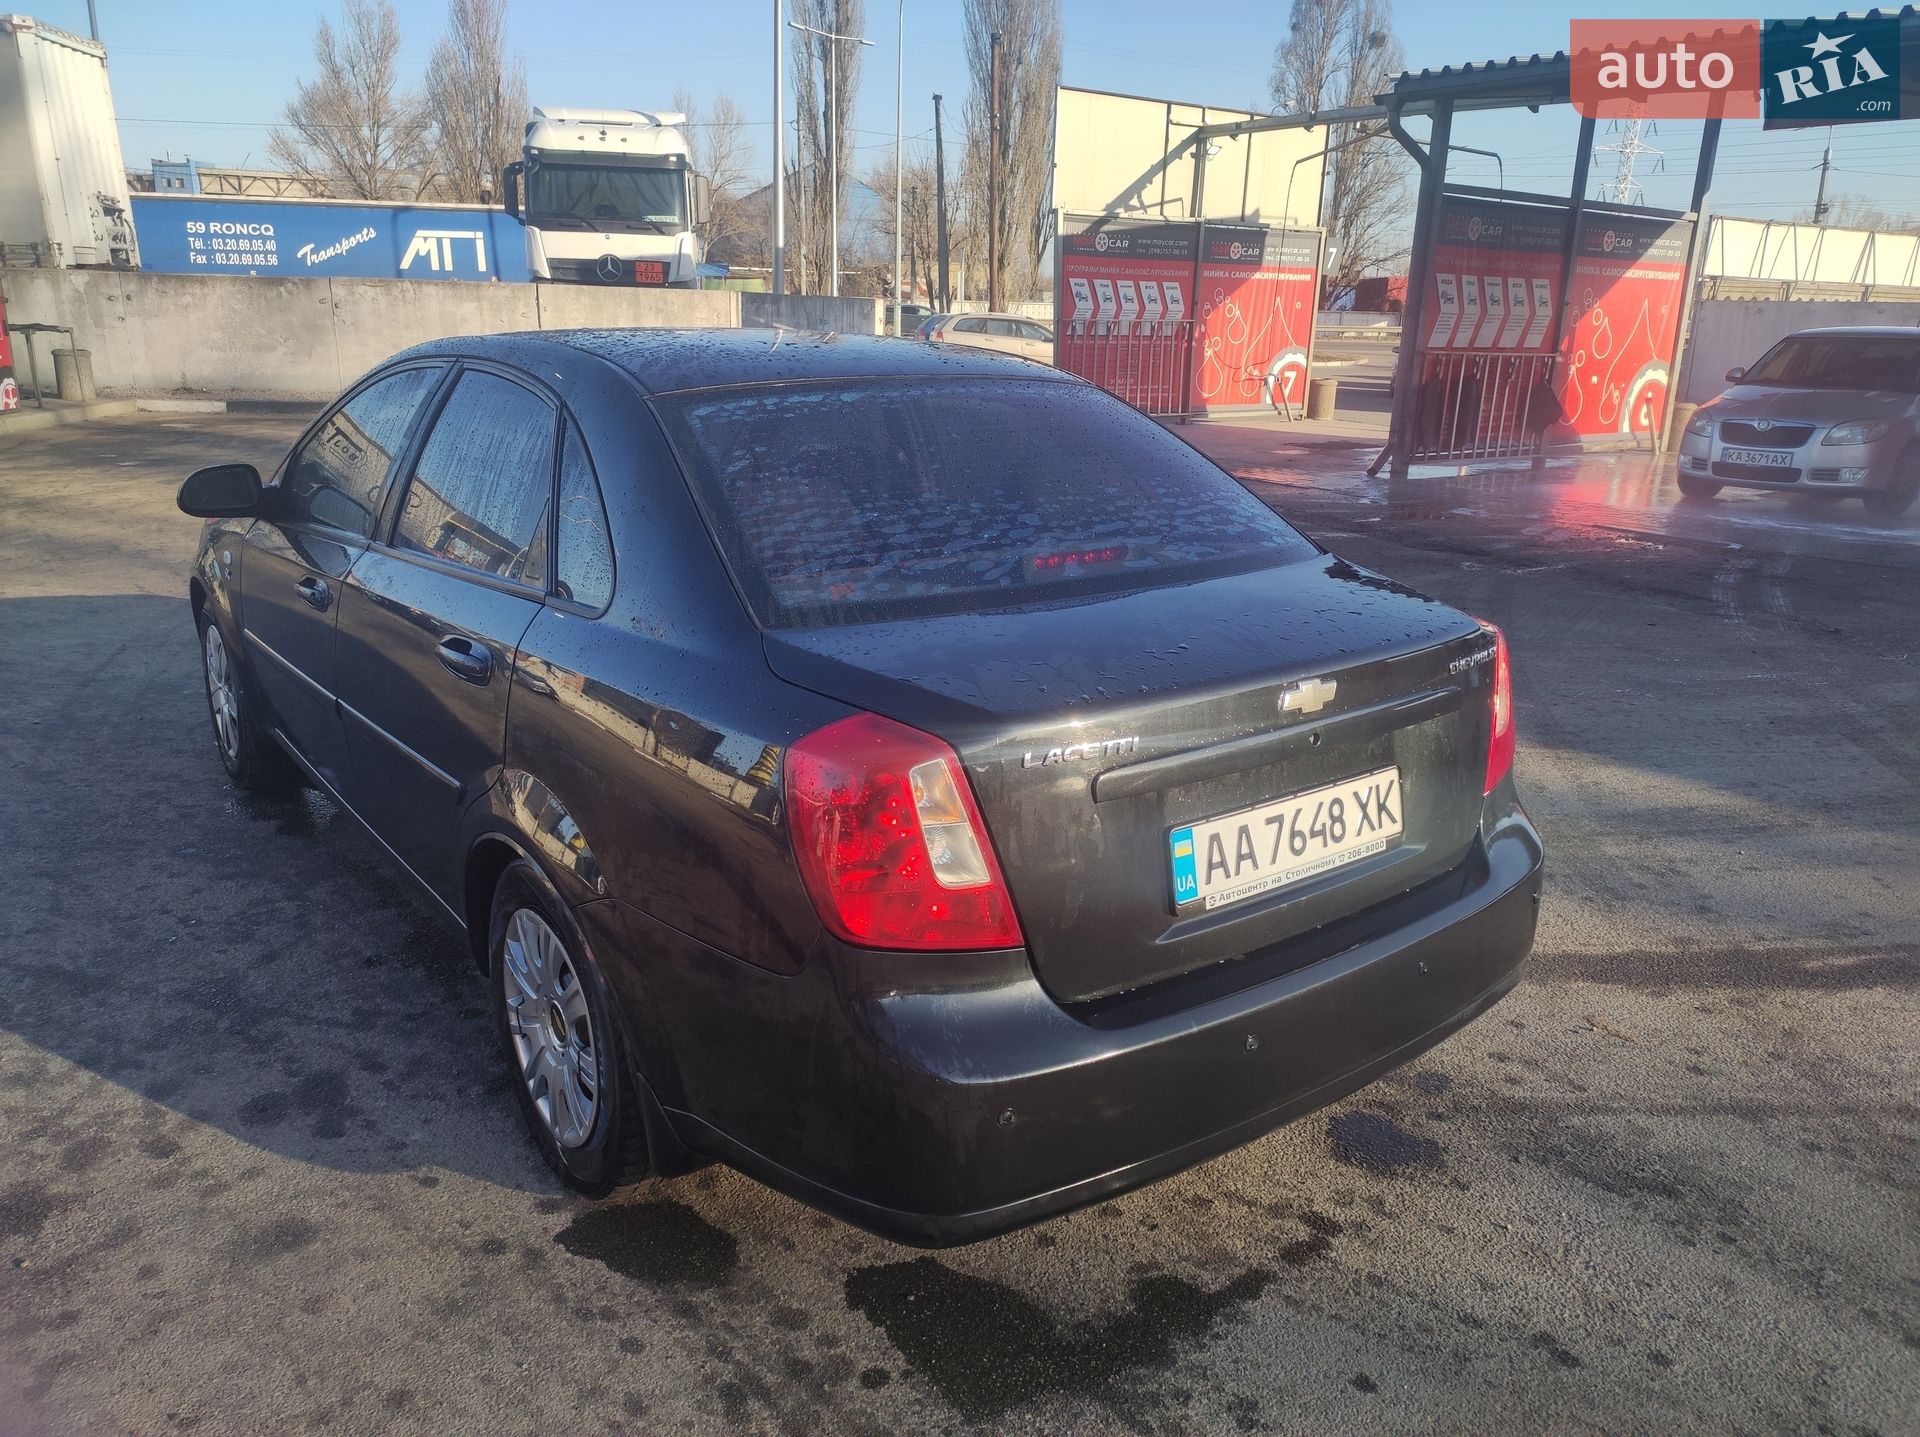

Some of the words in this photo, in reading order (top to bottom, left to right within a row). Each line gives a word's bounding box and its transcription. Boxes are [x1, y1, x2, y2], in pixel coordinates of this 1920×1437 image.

[186, 222, 206, 233] 59
[209, 222, 275, 236] RONCQ
[1481, 225, 1503, 236] CAR
[297, 226, 377, 267] Transports
[1108, 239, 1129, 248] CAR
[1615, 238, 1632, 248] CAR
[190, 252, 207, 264] Fax
[1241, 247, 1260, 256] CAR
[1327, 247, 1338, 269] 7
[643, 263, 655, 271] 23
[1203, 269, 1229, 277] МИЙКА
[639, 273, 661, 281] 1965
[1283, 371, 1297, 398] 7
[1727, 451, 1742, 462] KA
[1744, 453, 1769, 464] 3671
[1770, 455, 1788, 465] AX
[1021, 736, 1140, 769] LACETTI
[1204, 823, 1259, 885] AA
[1265, 797, 1347, 866] 7648
[1352, 779, 1398, 837] XK
[1219, 879, 1268, 903] Автоцентр
[1271, 876, 1282, 885] на
[1285, 858, 1336, 881] Столичному
[1347, 841, 1385, 861] 206-8000
[1177, 877, 1196, 892] UA
